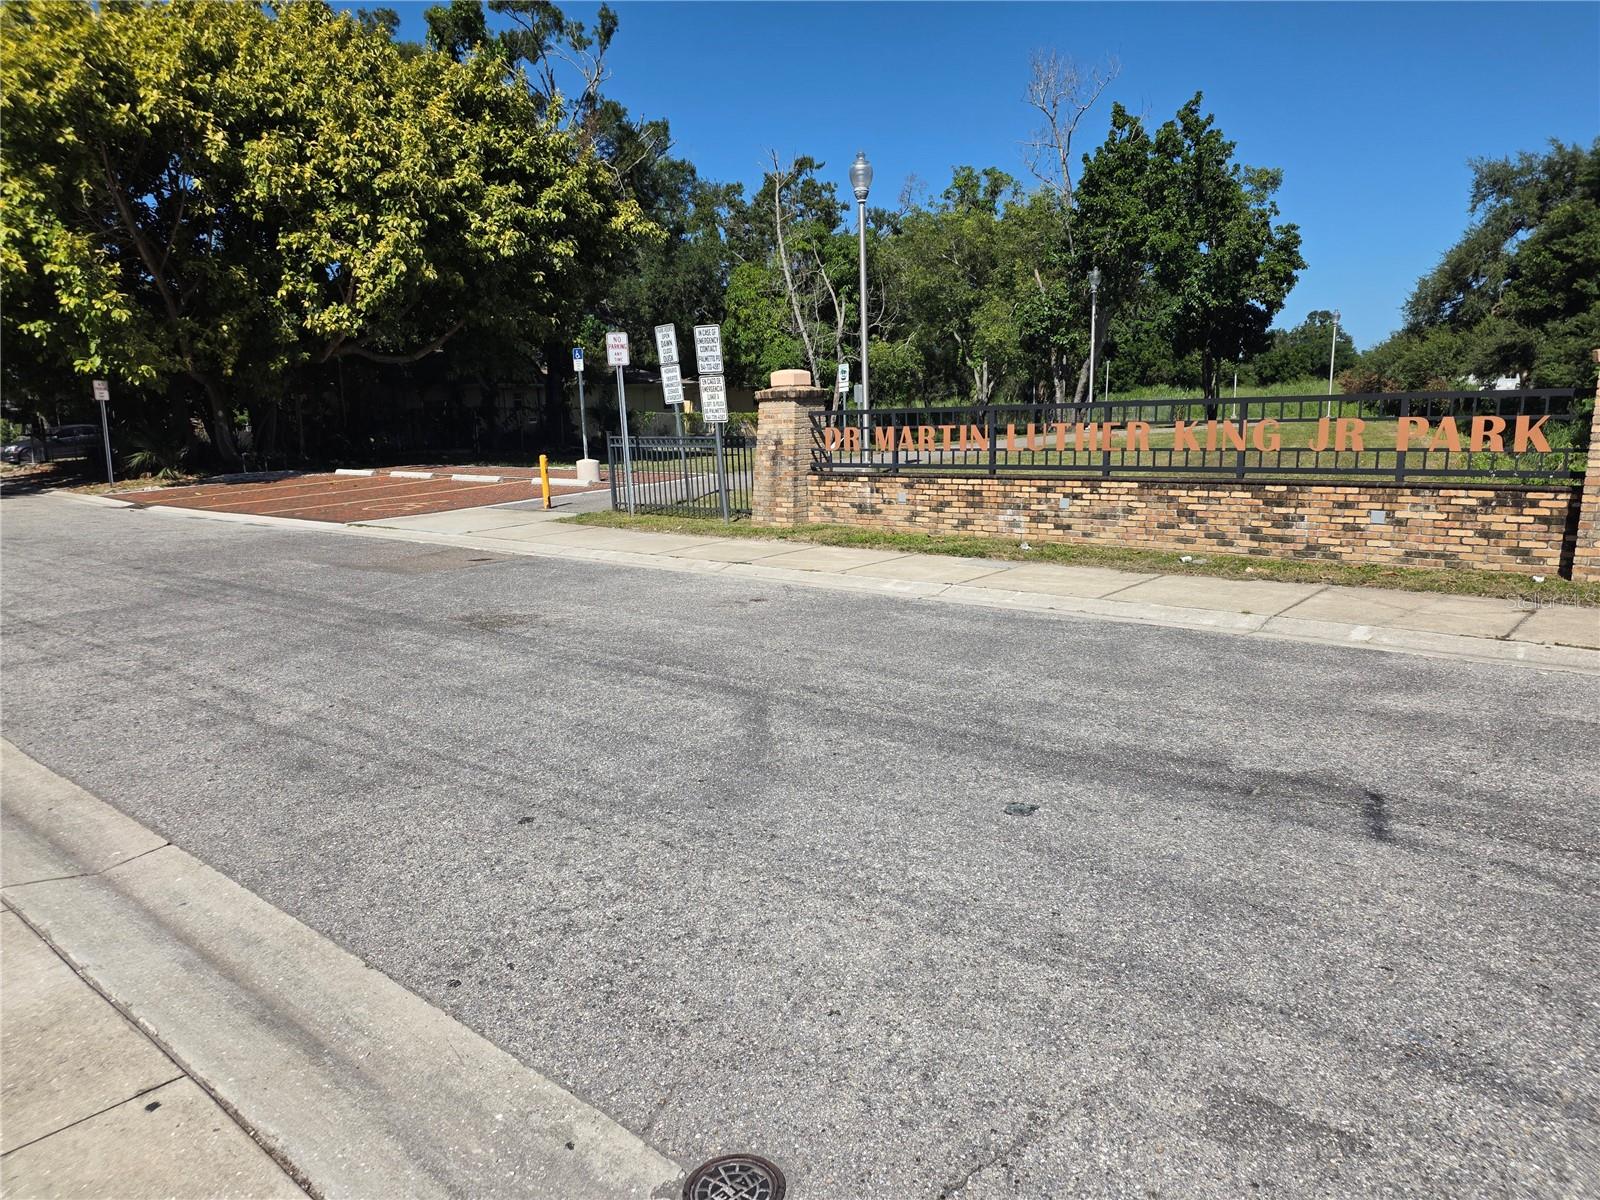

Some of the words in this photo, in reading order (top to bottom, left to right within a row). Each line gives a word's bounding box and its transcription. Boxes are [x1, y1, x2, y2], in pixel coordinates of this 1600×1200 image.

[825, 427, 860, 451] DR
[875, 424, 989, 451] MARTIN
[1006, 421, 1150, 451] LUTHER
[1174, 418, 1281, 452] KING
[1308, 417, 1366, 452] JR
[1396, 415, 1552, 453] PARK
